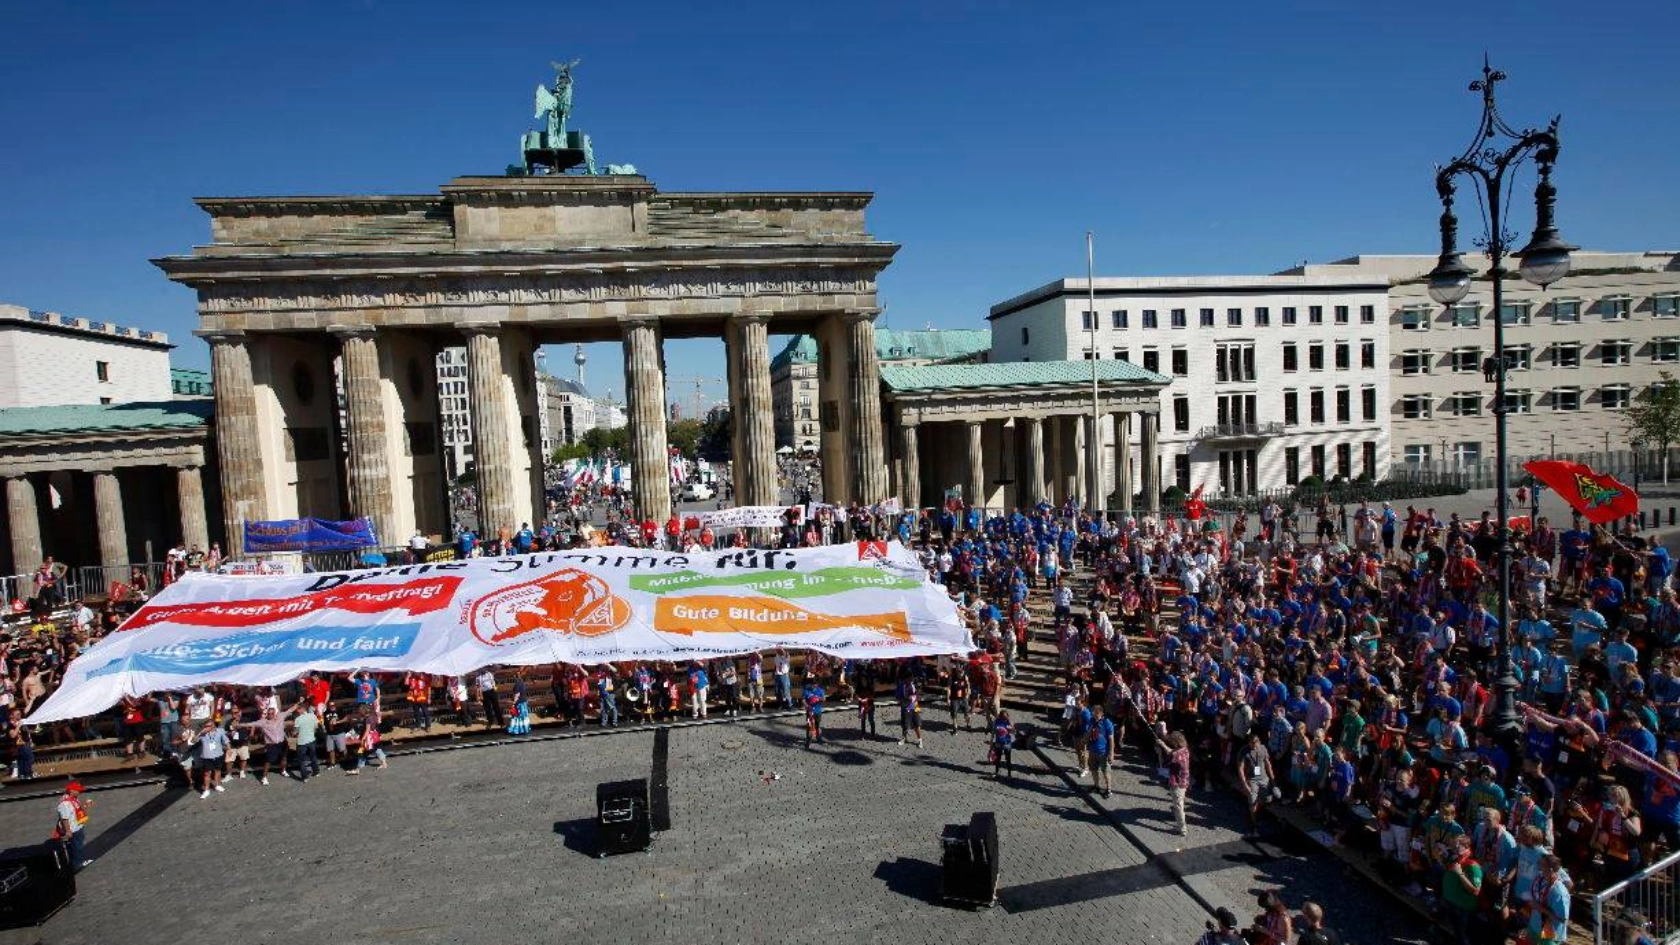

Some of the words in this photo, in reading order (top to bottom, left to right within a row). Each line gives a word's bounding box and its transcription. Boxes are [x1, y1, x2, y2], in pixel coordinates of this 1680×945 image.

[802, 574, 825, 585] im
[672, 604, 720, 619] Gute
[296, 637, 347, 650] und
[353, 635, 400, 651] fair!
